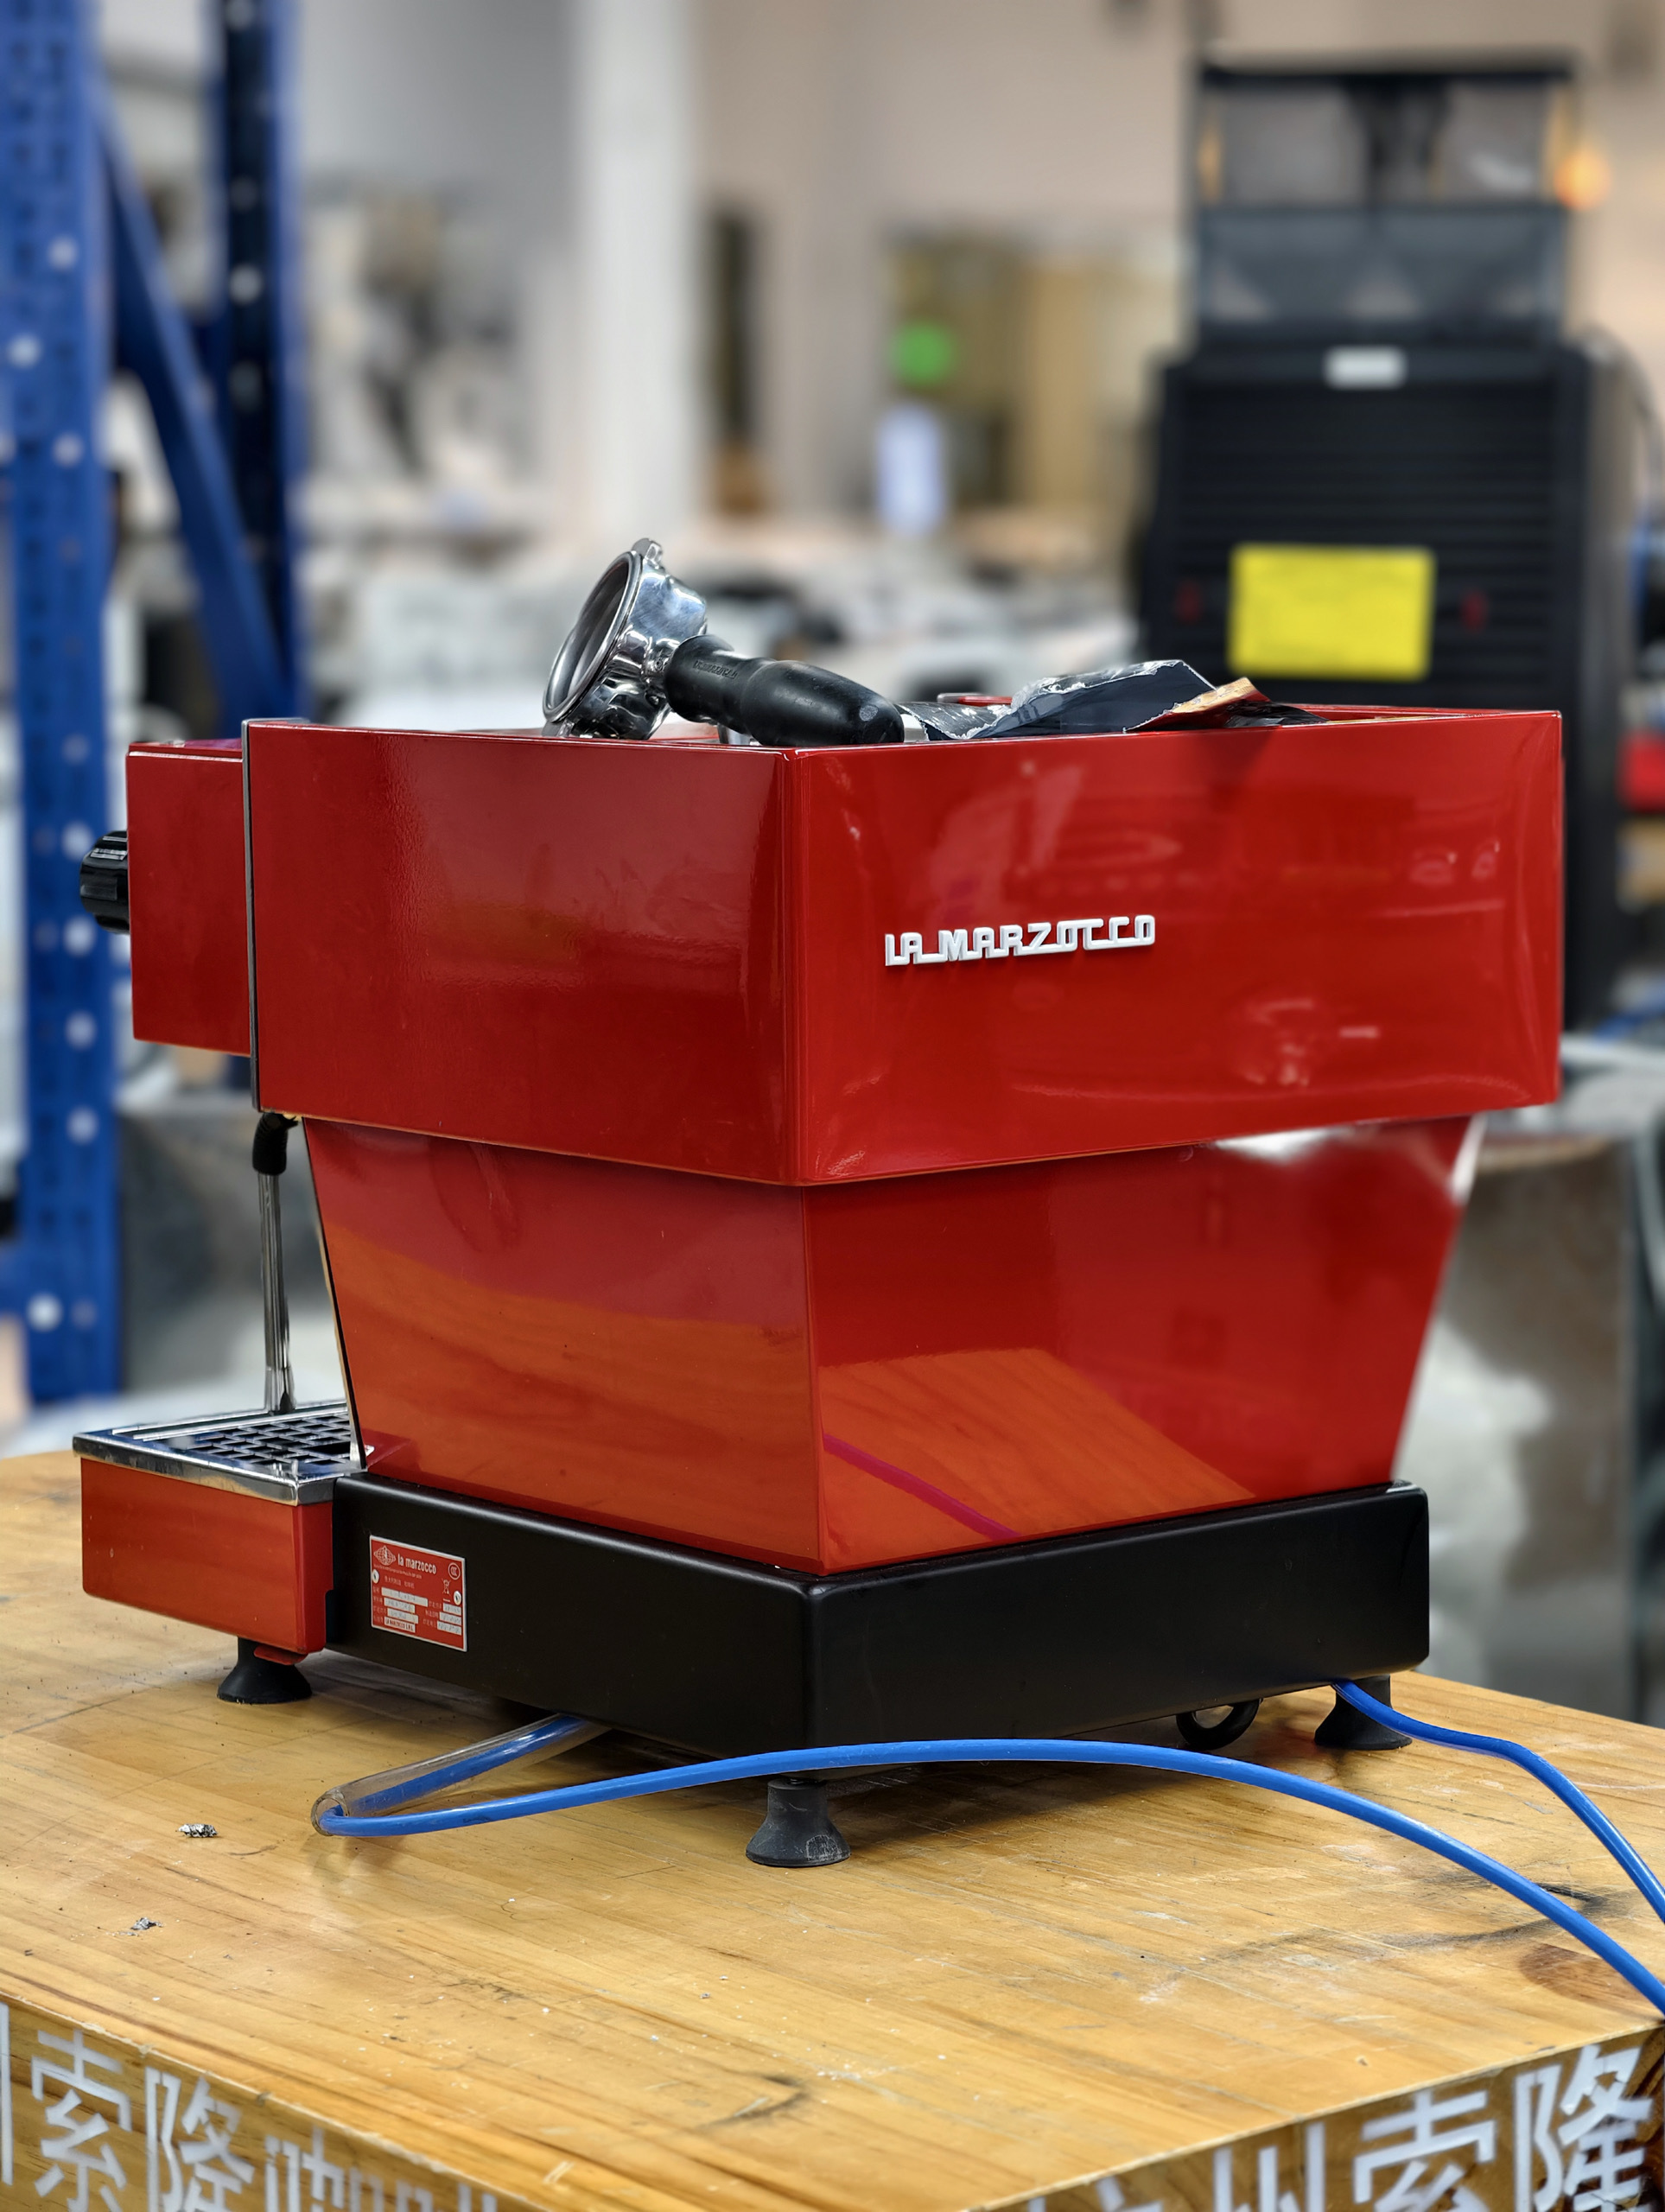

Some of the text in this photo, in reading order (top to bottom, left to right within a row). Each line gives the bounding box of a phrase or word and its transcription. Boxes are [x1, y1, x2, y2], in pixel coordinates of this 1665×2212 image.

[885, 914, 1156, 966] LA MARZOCCO
[397, 1554, 404, 1566] la
[405, 1559, 436, 1574] marzocco
